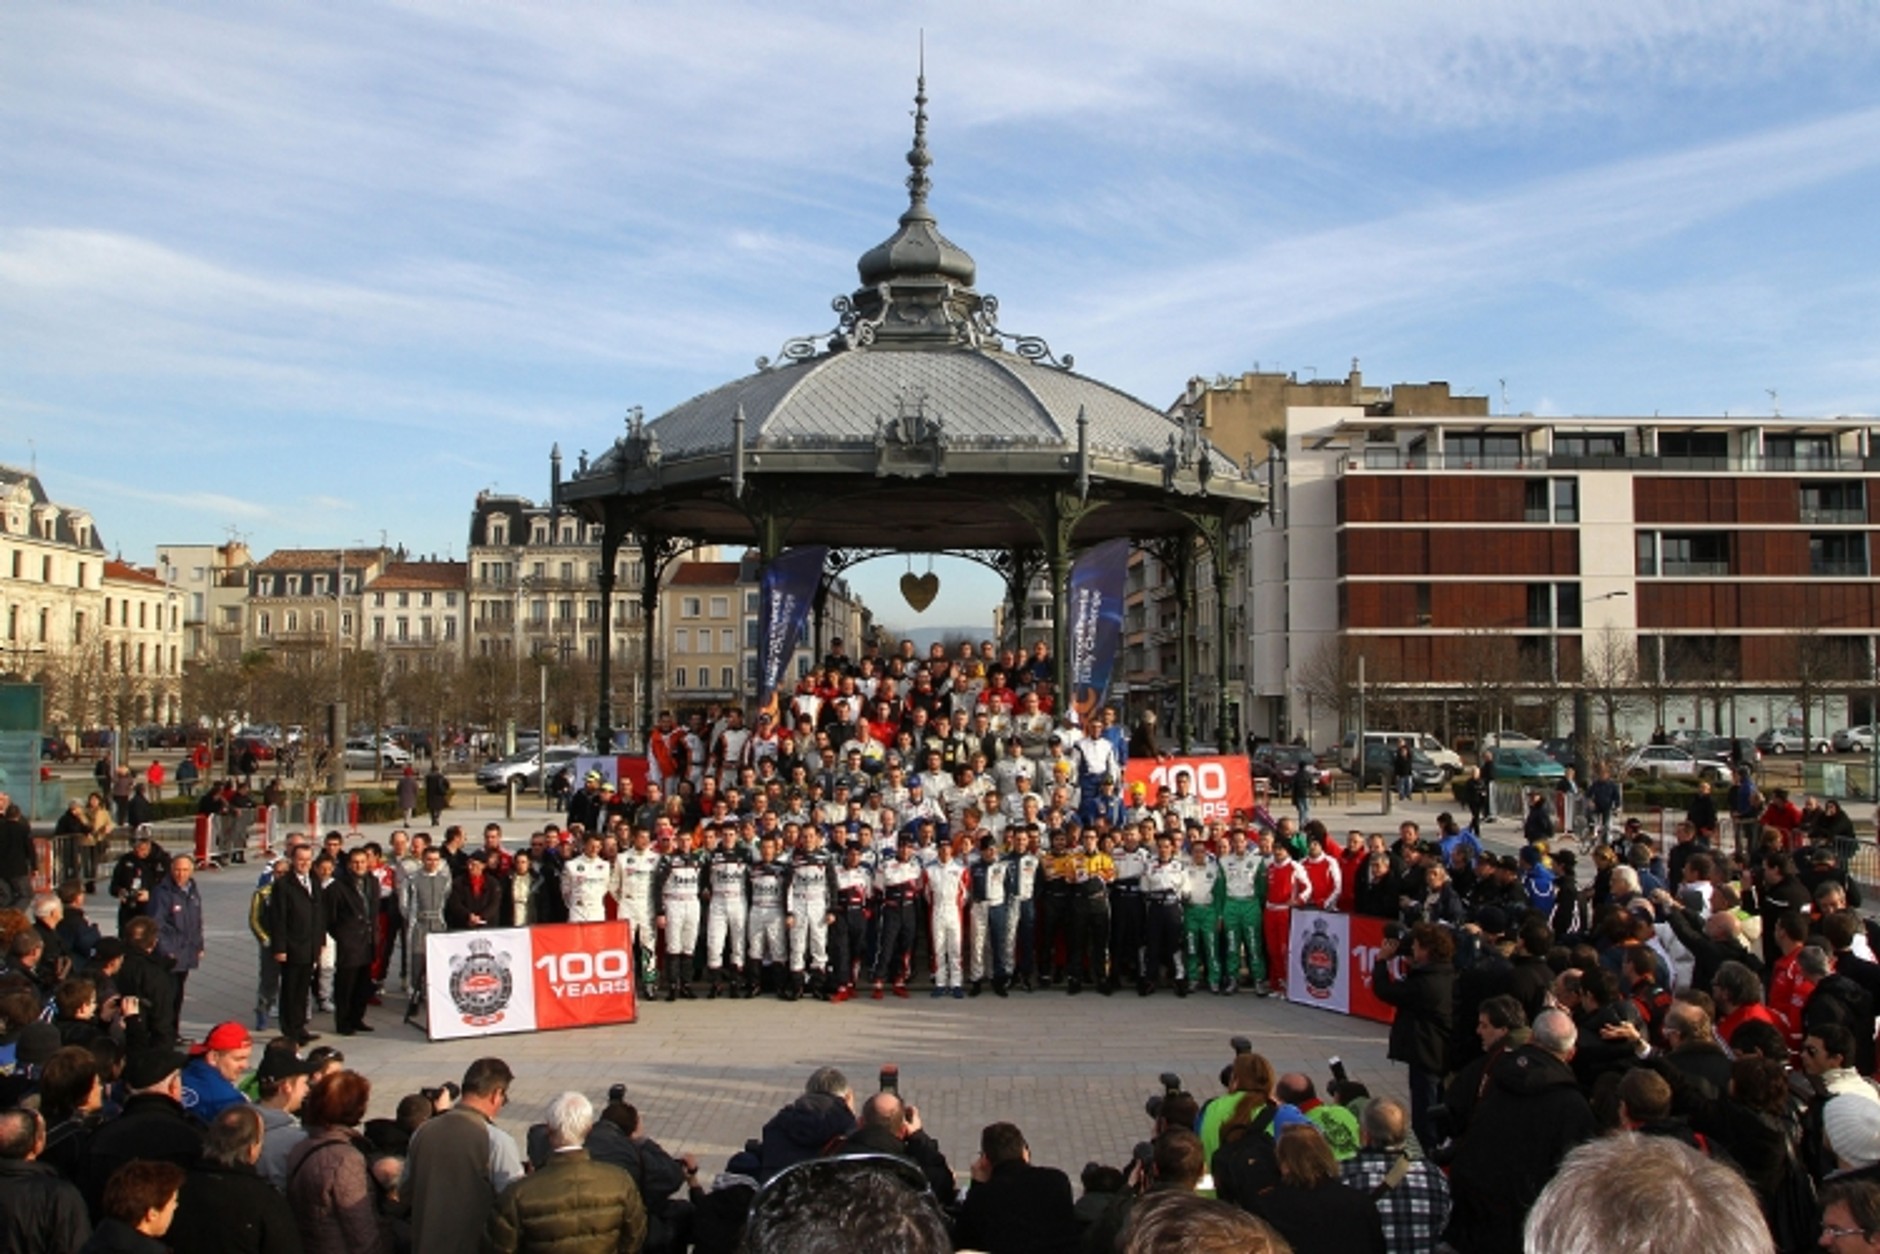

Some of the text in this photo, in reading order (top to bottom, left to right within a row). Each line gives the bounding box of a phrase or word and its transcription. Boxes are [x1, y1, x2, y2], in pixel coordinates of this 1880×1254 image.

[1149, 762, 1227, 799] 100
[535, 949, 629, 983] 100
[551, 979, 630, 998] YEARS
